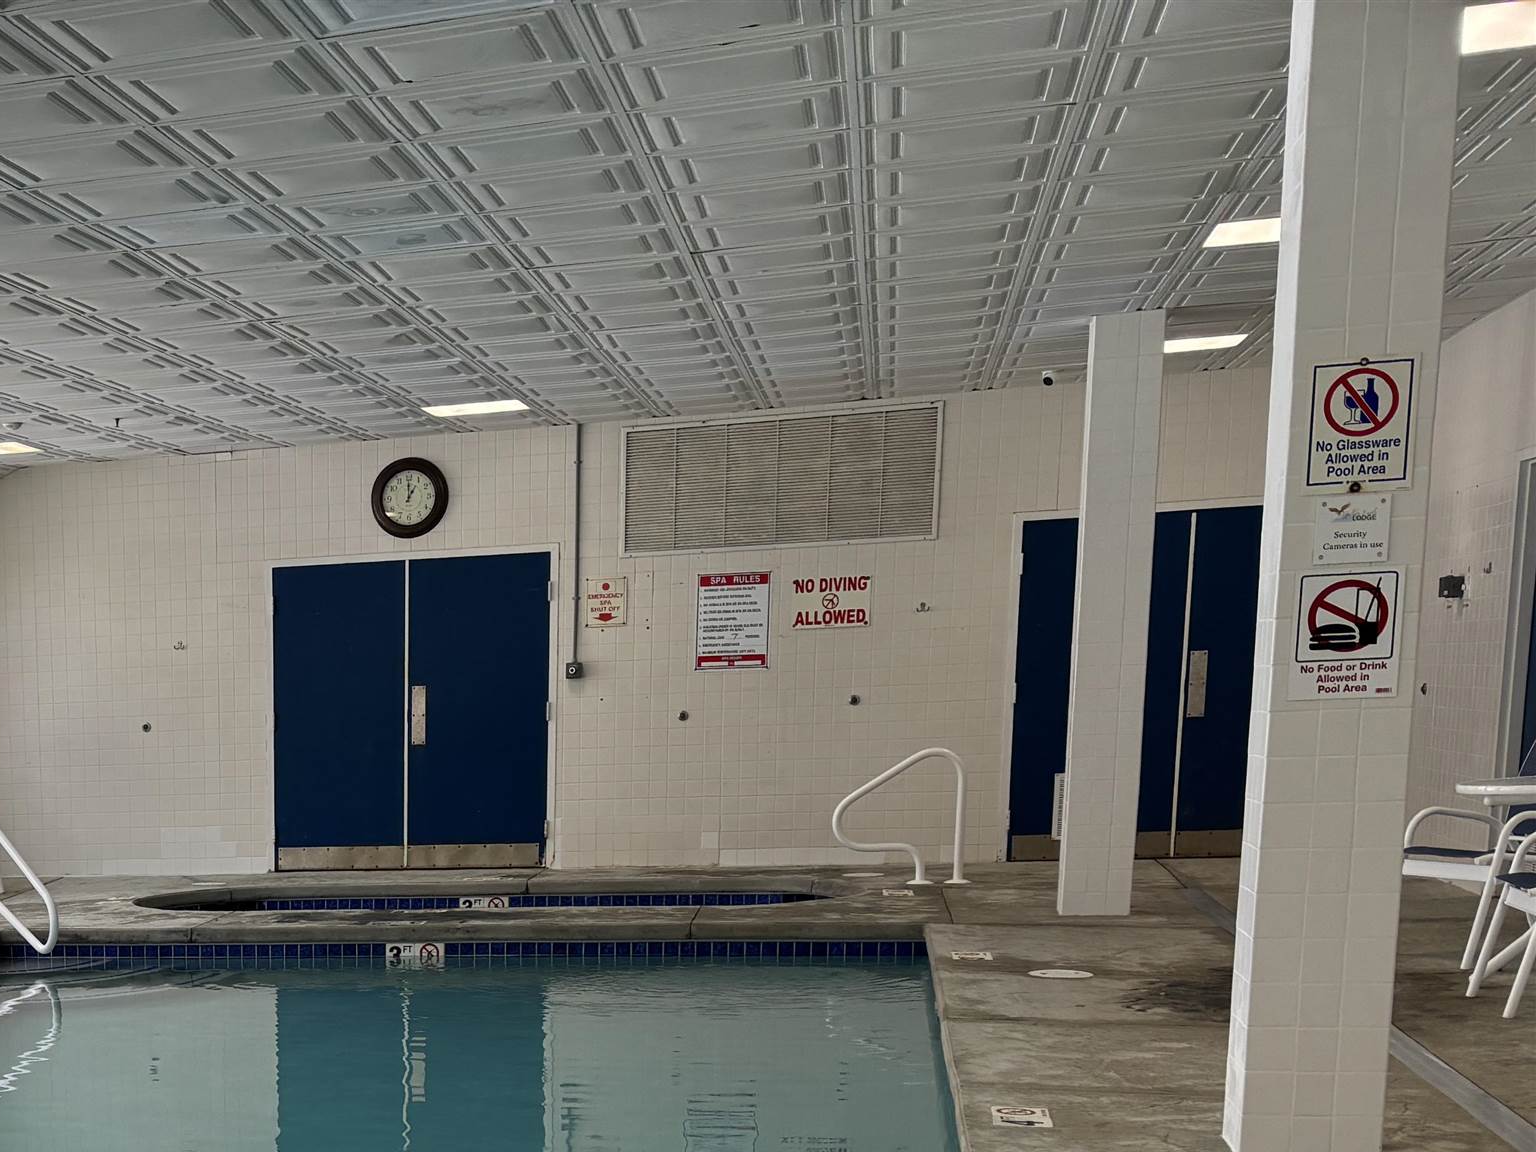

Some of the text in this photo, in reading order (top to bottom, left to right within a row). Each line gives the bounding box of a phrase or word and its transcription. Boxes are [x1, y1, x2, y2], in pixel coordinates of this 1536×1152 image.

[1316, 437, 1401, 452] No Glassware
[1325, 450, 1389, 465] Allowed in
[1326, 464, 1386, 477] Pool Area
[1333, 530, 1368, 539] Security
[1323, 542, 1358, 550] Cameras
[710, 575, 761, 585] SPA RULES
[795, 576, 868, 593] NO DIVING
[795, 609, 866, 625] ALLOWED
[1300, 665, 1314, 674] No
[1317, 663, 1343, 673] Food
[1359, 661, 1388, 671] Drink
[1316, 672, 1370, 684] Allowed in
[1317, 684, 1340, 694] Pool
[1343, 683, 1368, 692] Area
